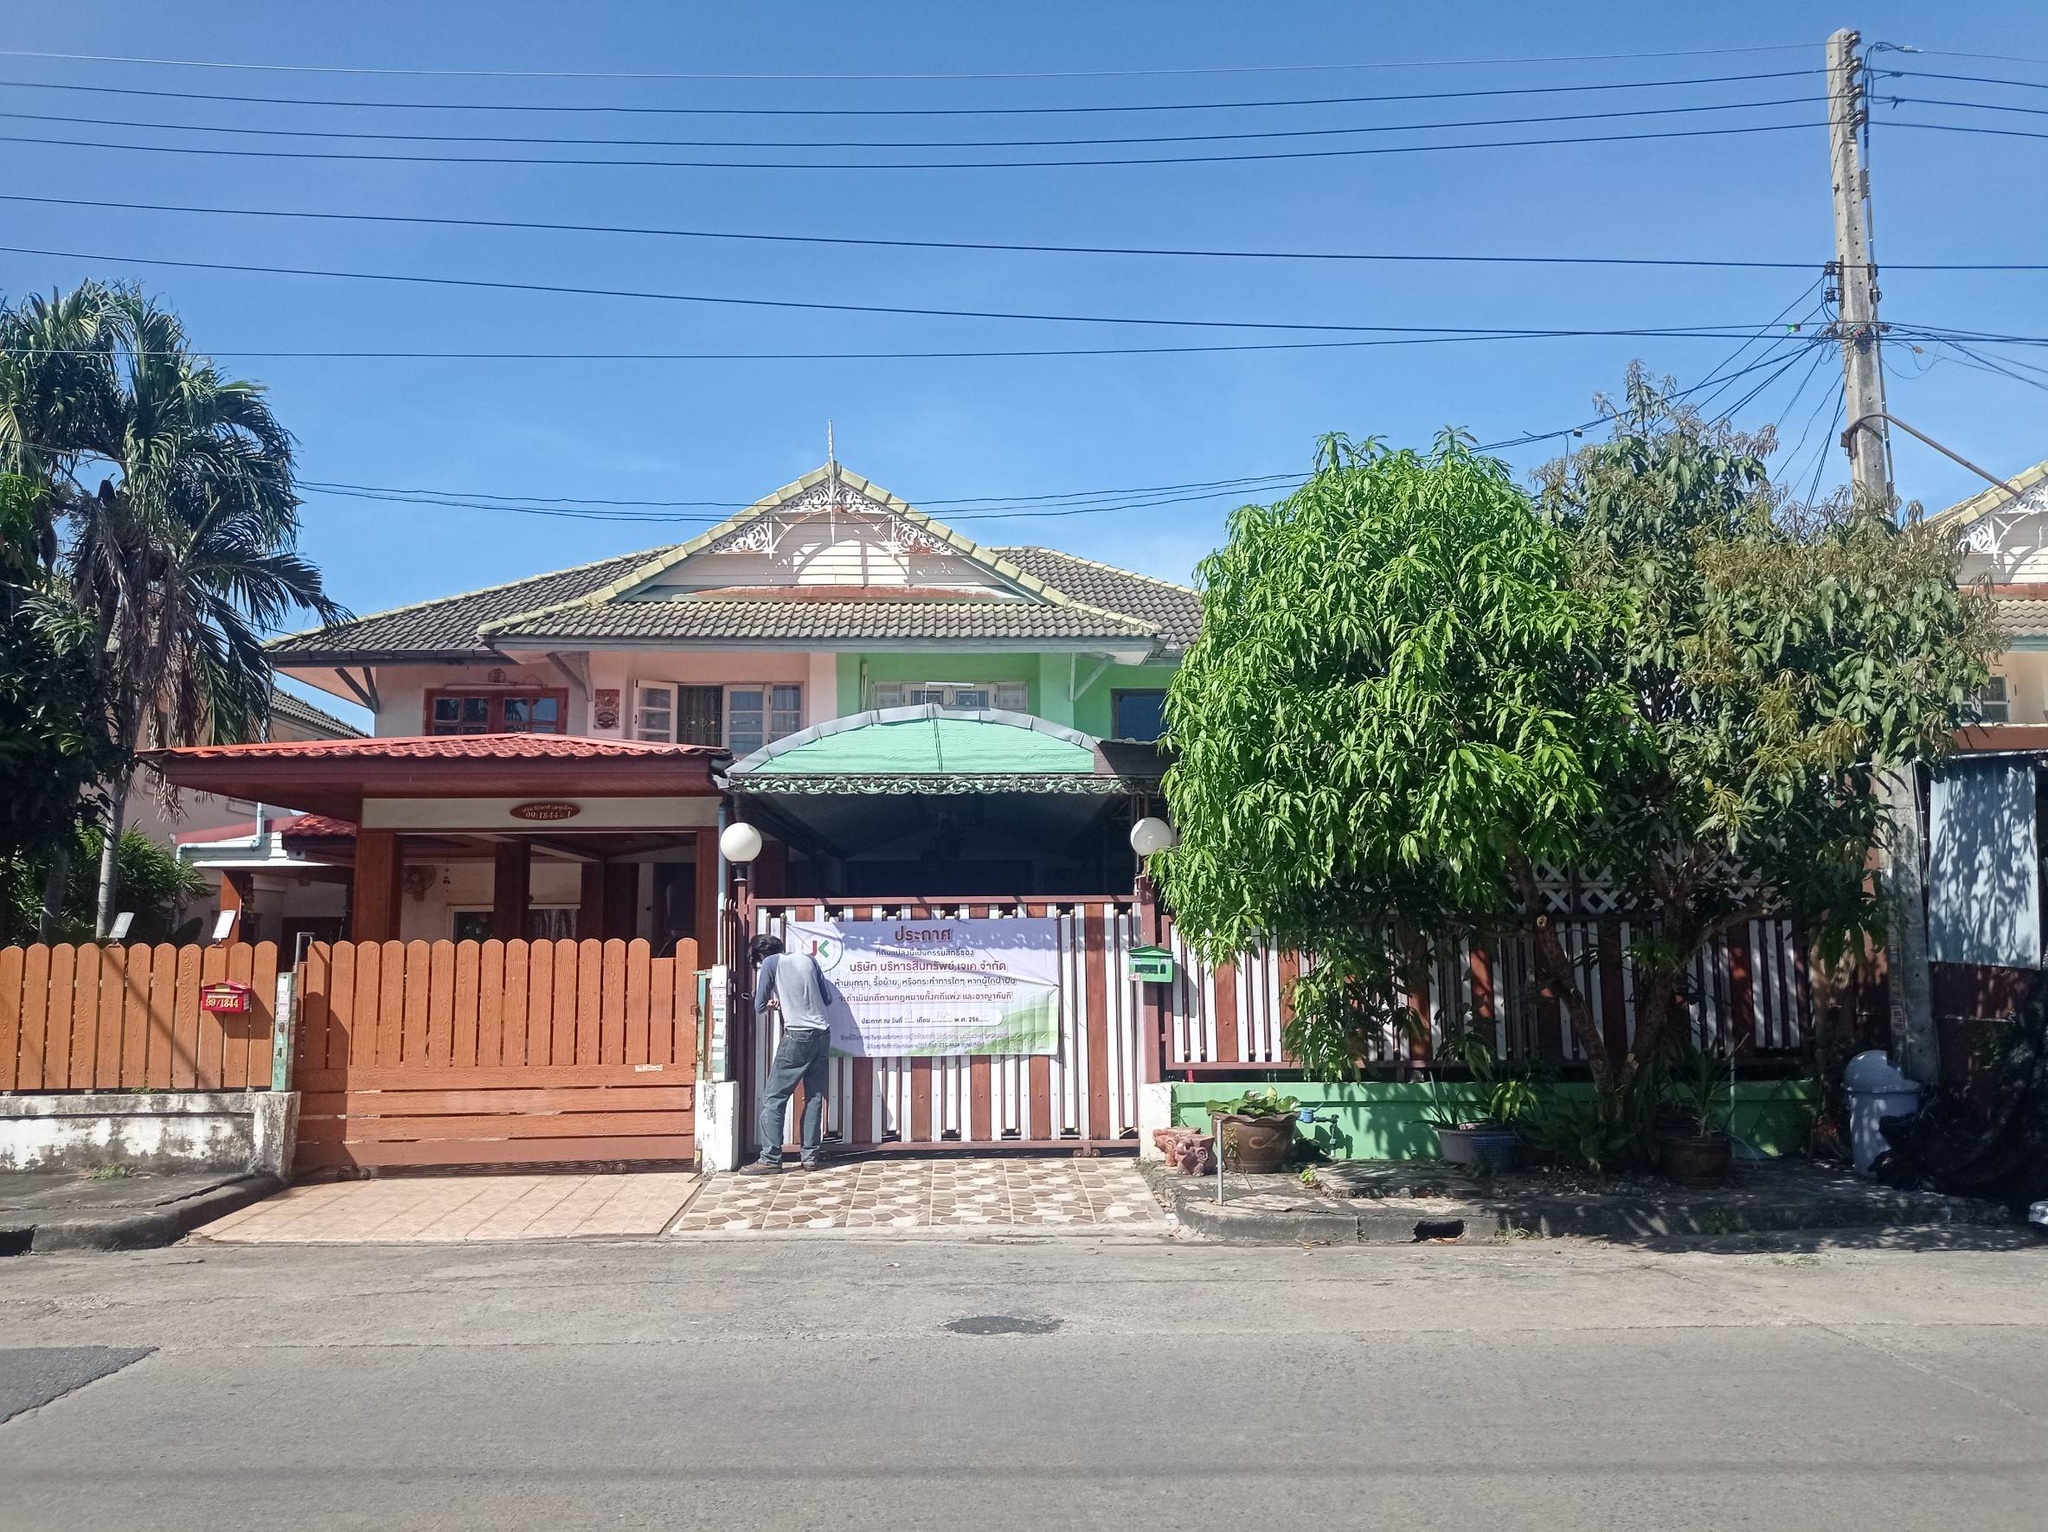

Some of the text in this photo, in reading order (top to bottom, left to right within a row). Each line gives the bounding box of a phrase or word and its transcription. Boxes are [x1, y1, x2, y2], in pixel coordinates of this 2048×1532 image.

[894, 925, 953, 942] ประกาศ
[849, 960, 1007, 972] บริษัท บริหารสินทรัพย์ เจเค จำกัด
[205, 997, 239, 1008] 99/1844
